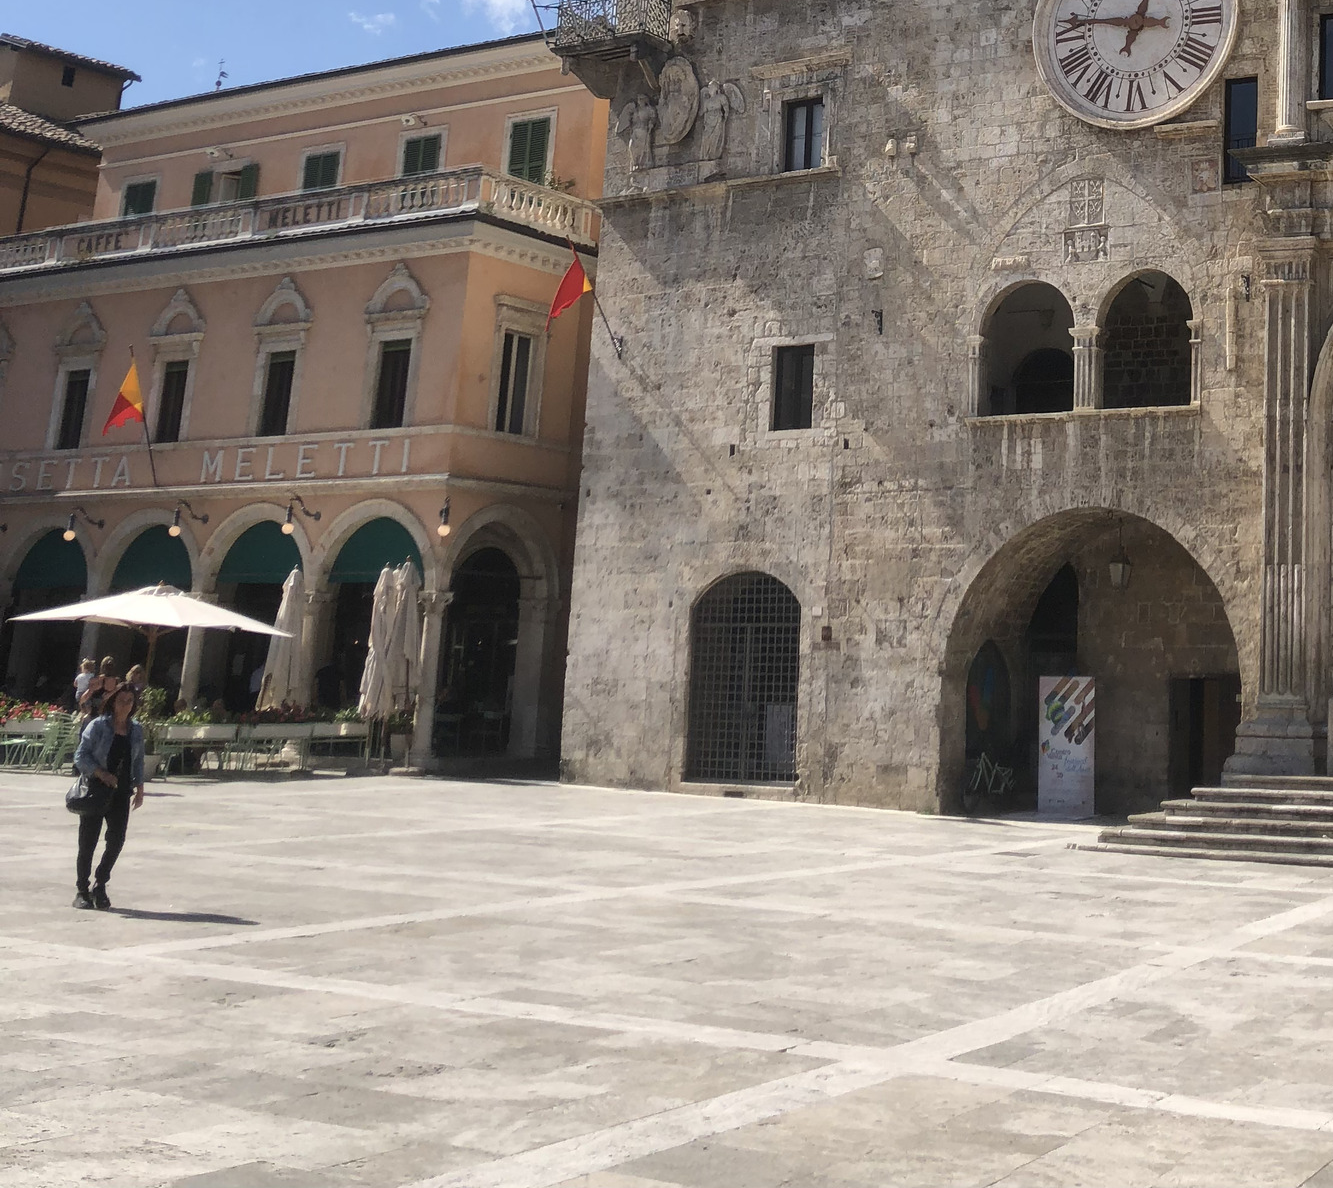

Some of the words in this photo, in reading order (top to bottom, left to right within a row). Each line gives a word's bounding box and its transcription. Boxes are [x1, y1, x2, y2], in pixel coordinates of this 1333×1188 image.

[1191, 3, 1223, 26] III
[1059, 46, 1094, 89] VIII
[1176, 36, 1216, 73] IIII
[1083, 70, 1114, 109] VII
[1124, 79, 1149, 111] VI
[1162, 70, 1186, 100] V
[269, 198, 341, 229] MELETTI
[0, 456, 131, 492] SETTA
[200, 438, 411, 483] MELETTI
